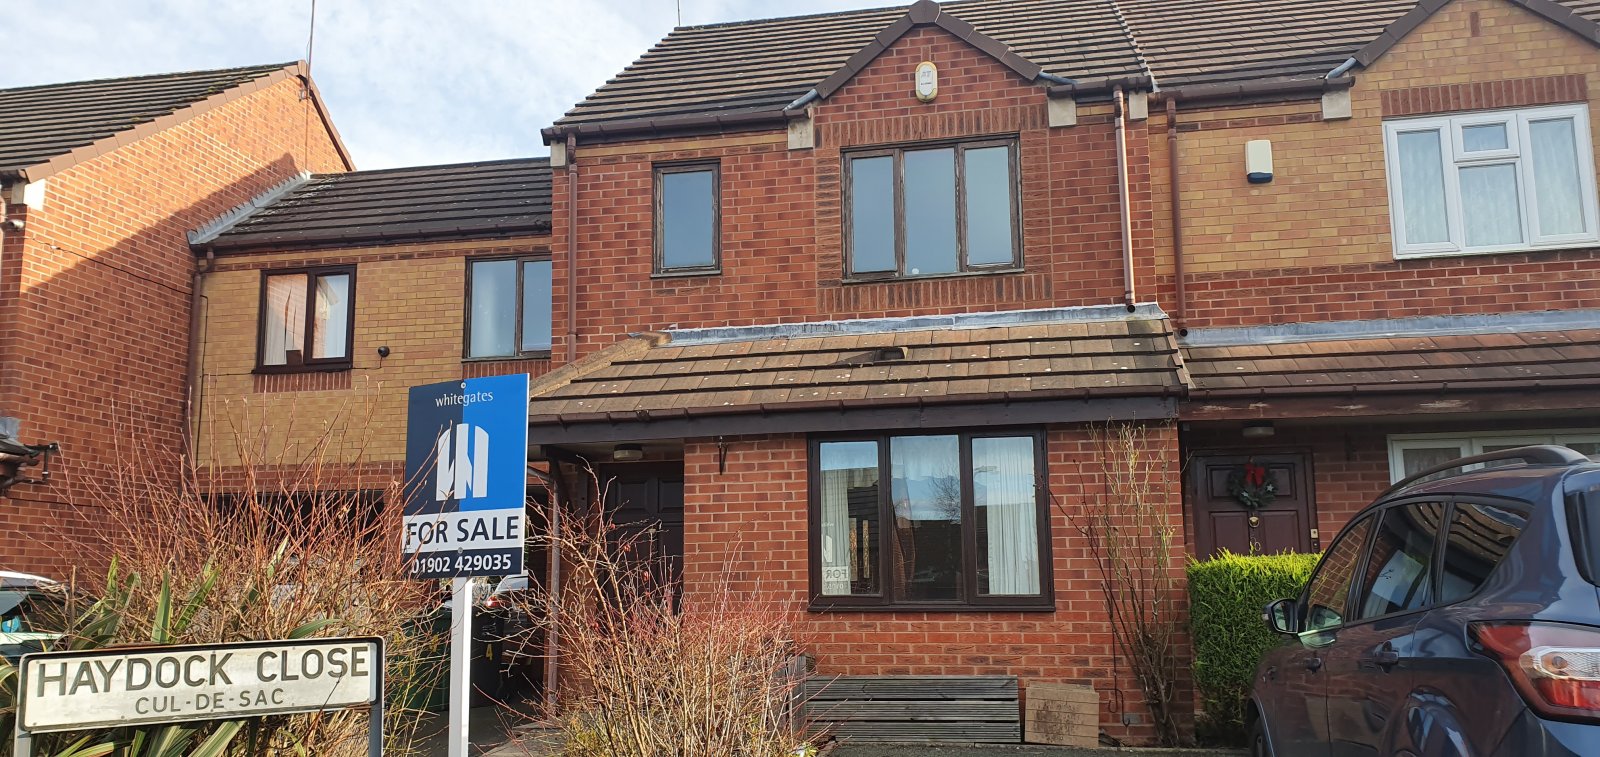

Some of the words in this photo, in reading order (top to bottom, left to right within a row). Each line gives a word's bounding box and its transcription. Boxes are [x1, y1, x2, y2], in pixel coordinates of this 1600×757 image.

[435, 391, 494, 407] whitegates
[406, 521, 448, 546] FOR
[457, 515, 519, 542] SALE
[411, 557, 450, 574] 01902
[454, 553, 512, 571] 429035
[485, 643, 493, 661] 4
[36, 652, 235, 697] HAYDOCK
[256, 646, 369, 682] CLOSE
[135, 687, 284, 715] CUL-DE-SAC
